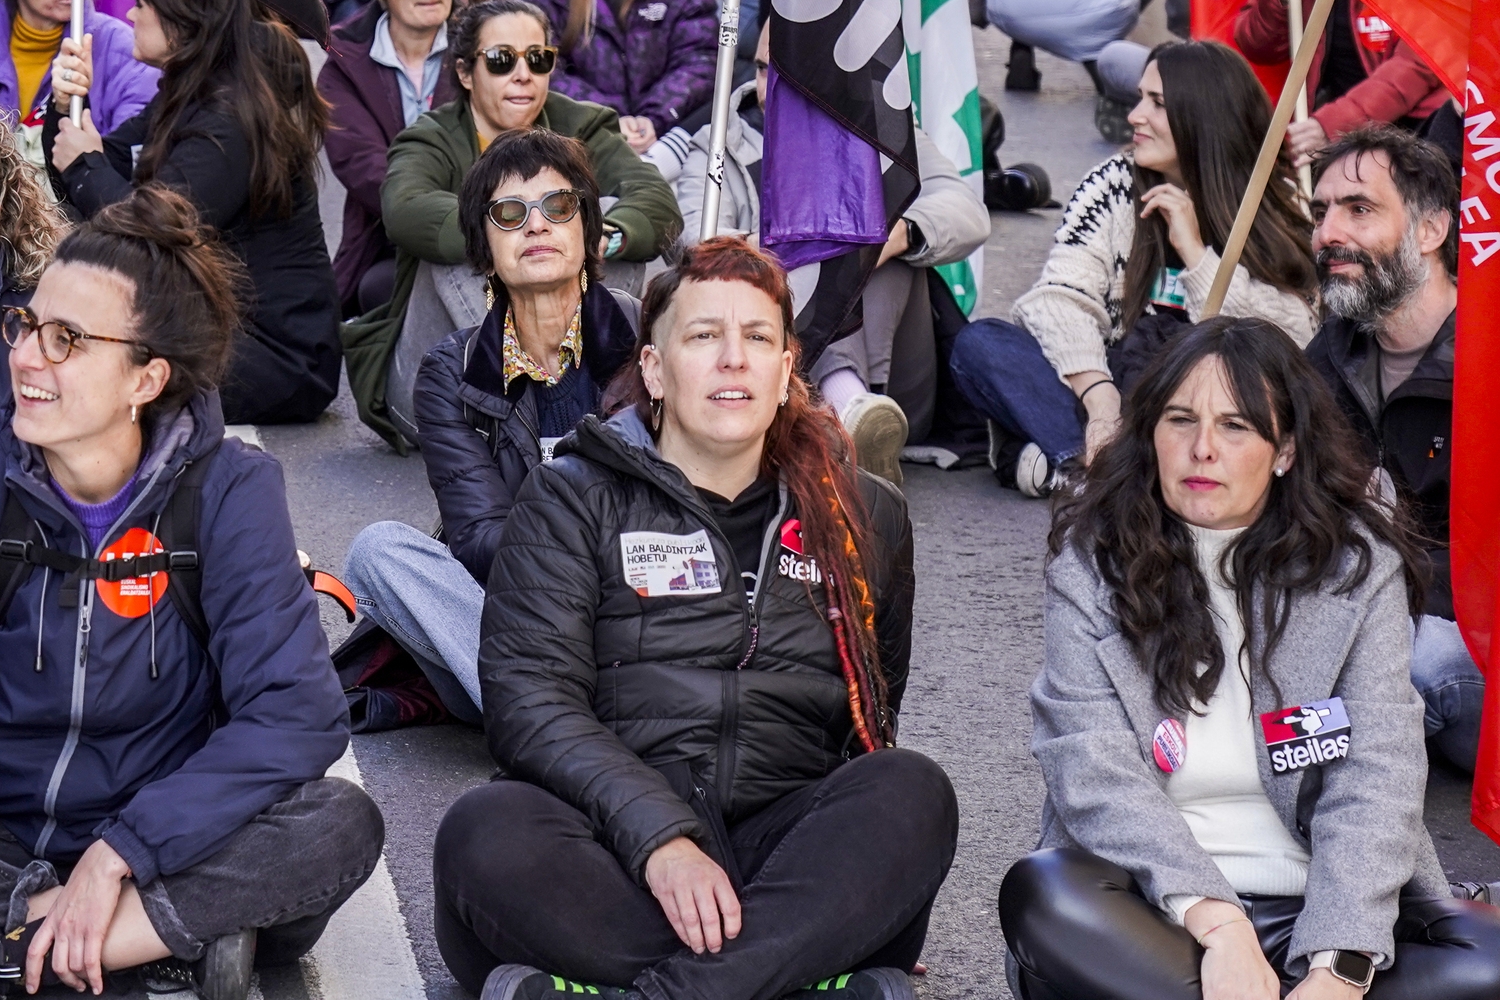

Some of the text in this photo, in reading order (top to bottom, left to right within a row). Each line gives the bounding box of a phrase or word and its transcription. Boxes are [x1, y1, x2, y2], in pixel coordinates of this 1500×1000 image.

[626, 543, 707, 555] LAN BALDINTZAK
[627, 554, 667, 564] HOBETU!
[1272, 734, 1350, 772] steilas
